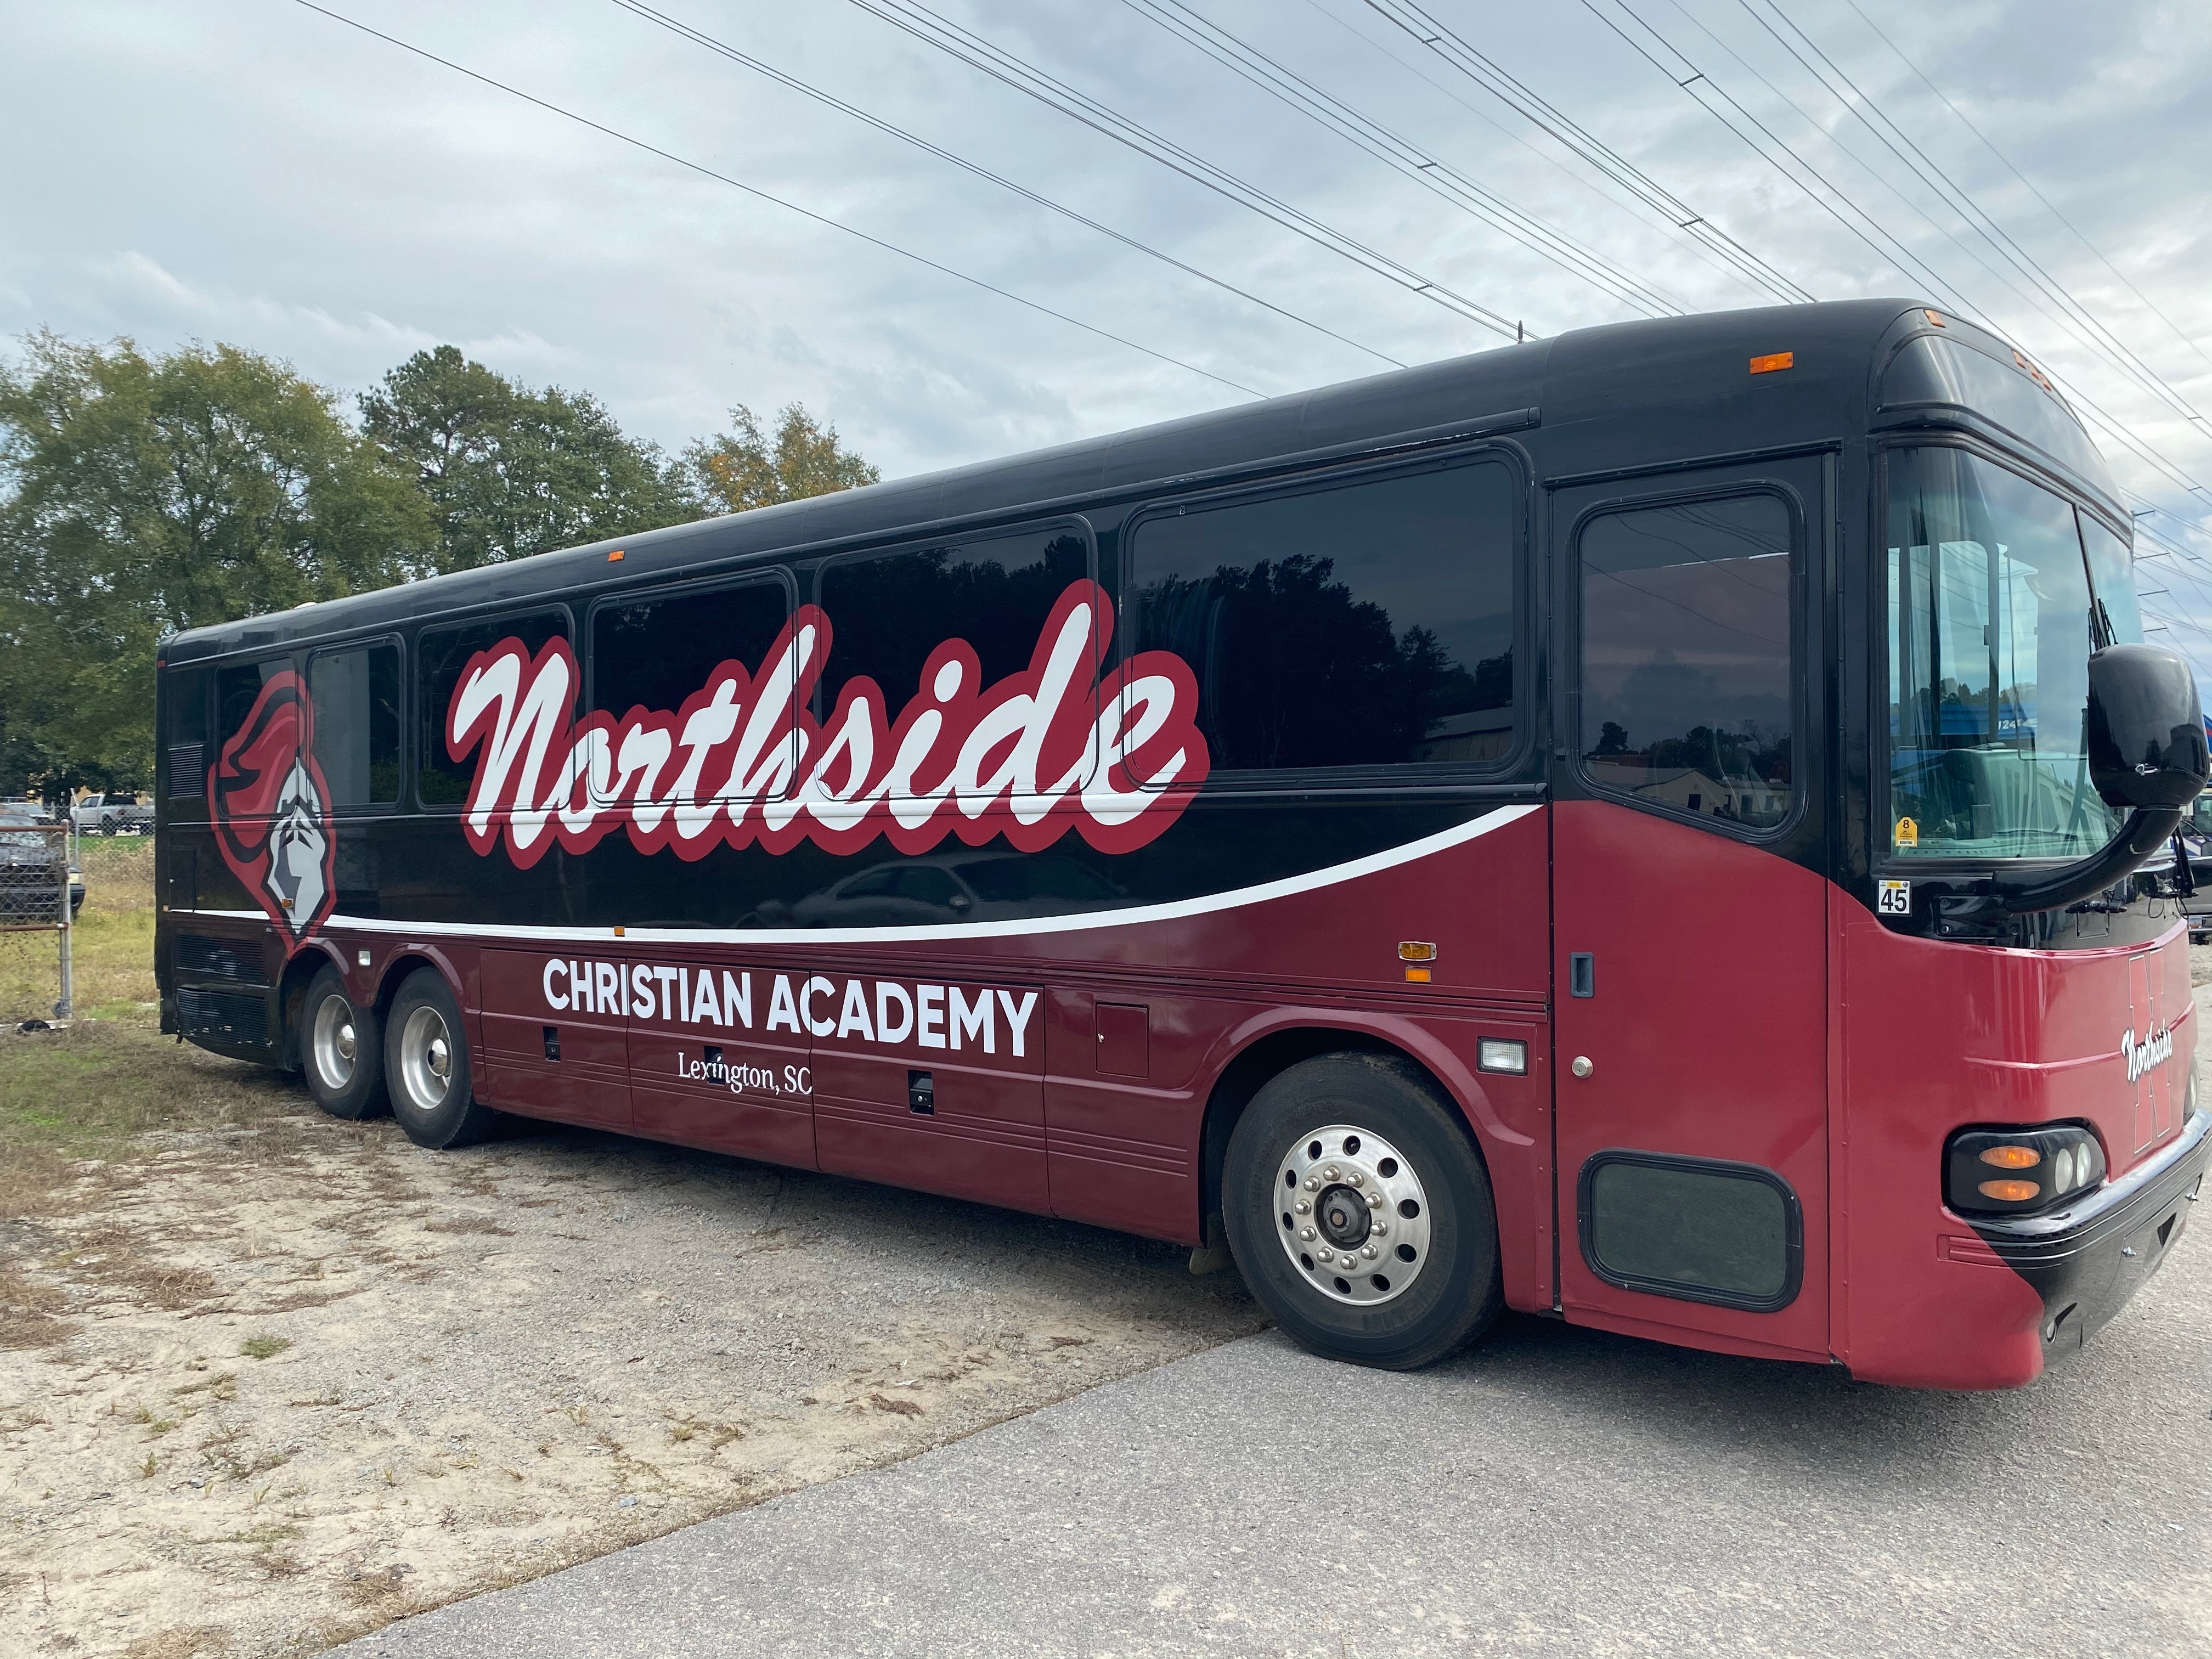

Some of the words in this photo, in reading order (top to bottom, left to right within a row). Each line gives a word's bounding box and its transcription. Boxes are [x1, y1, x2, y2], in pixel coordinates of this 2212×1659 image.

[454, 602, 1186, 849] Northside
[1903, 820, 1909, 828] 8
[1881, 888, 1907, 912] 45
[543, 958, 752, 1029] CHRISTIAN
[766, 974, 1039, 1057] ACADEMY
[678, 1052, 780, 1096] Lexington,
[784, 1065, 812, 1094] SC
[2121, 1018, 2172, 1082] Northside
